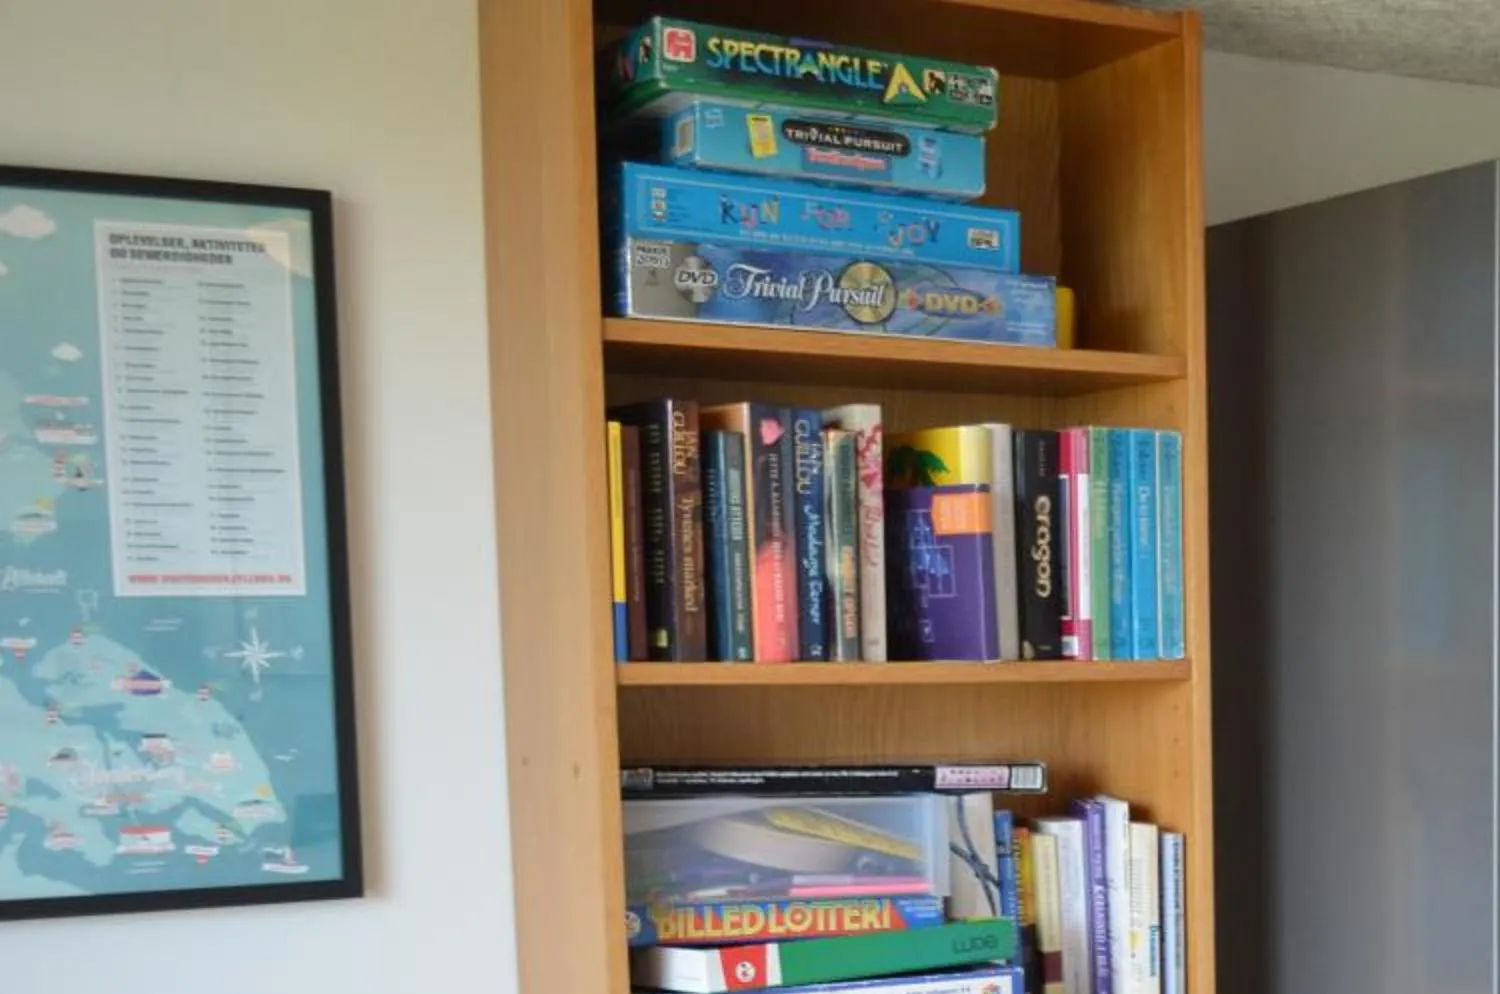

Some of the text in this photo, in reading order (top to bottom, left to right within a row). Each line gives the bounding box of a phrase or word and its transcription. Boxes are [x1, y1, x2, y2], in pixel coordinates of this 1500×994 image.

[705, 36, 884, 90] SPECTRANGLE
[785, 127, 903, 153] TRIVIAL PURSUIT
[677, 270, 716, 285] DVD
[723, 263, 803, 299] Trivial
[800, 268, 885, 312] Pursuit
[924, 292, 980, 314] DVD
[1031, 495, 1052, 598] eragon
[657, 898, 892, 939] BILLEDLOTTERI
